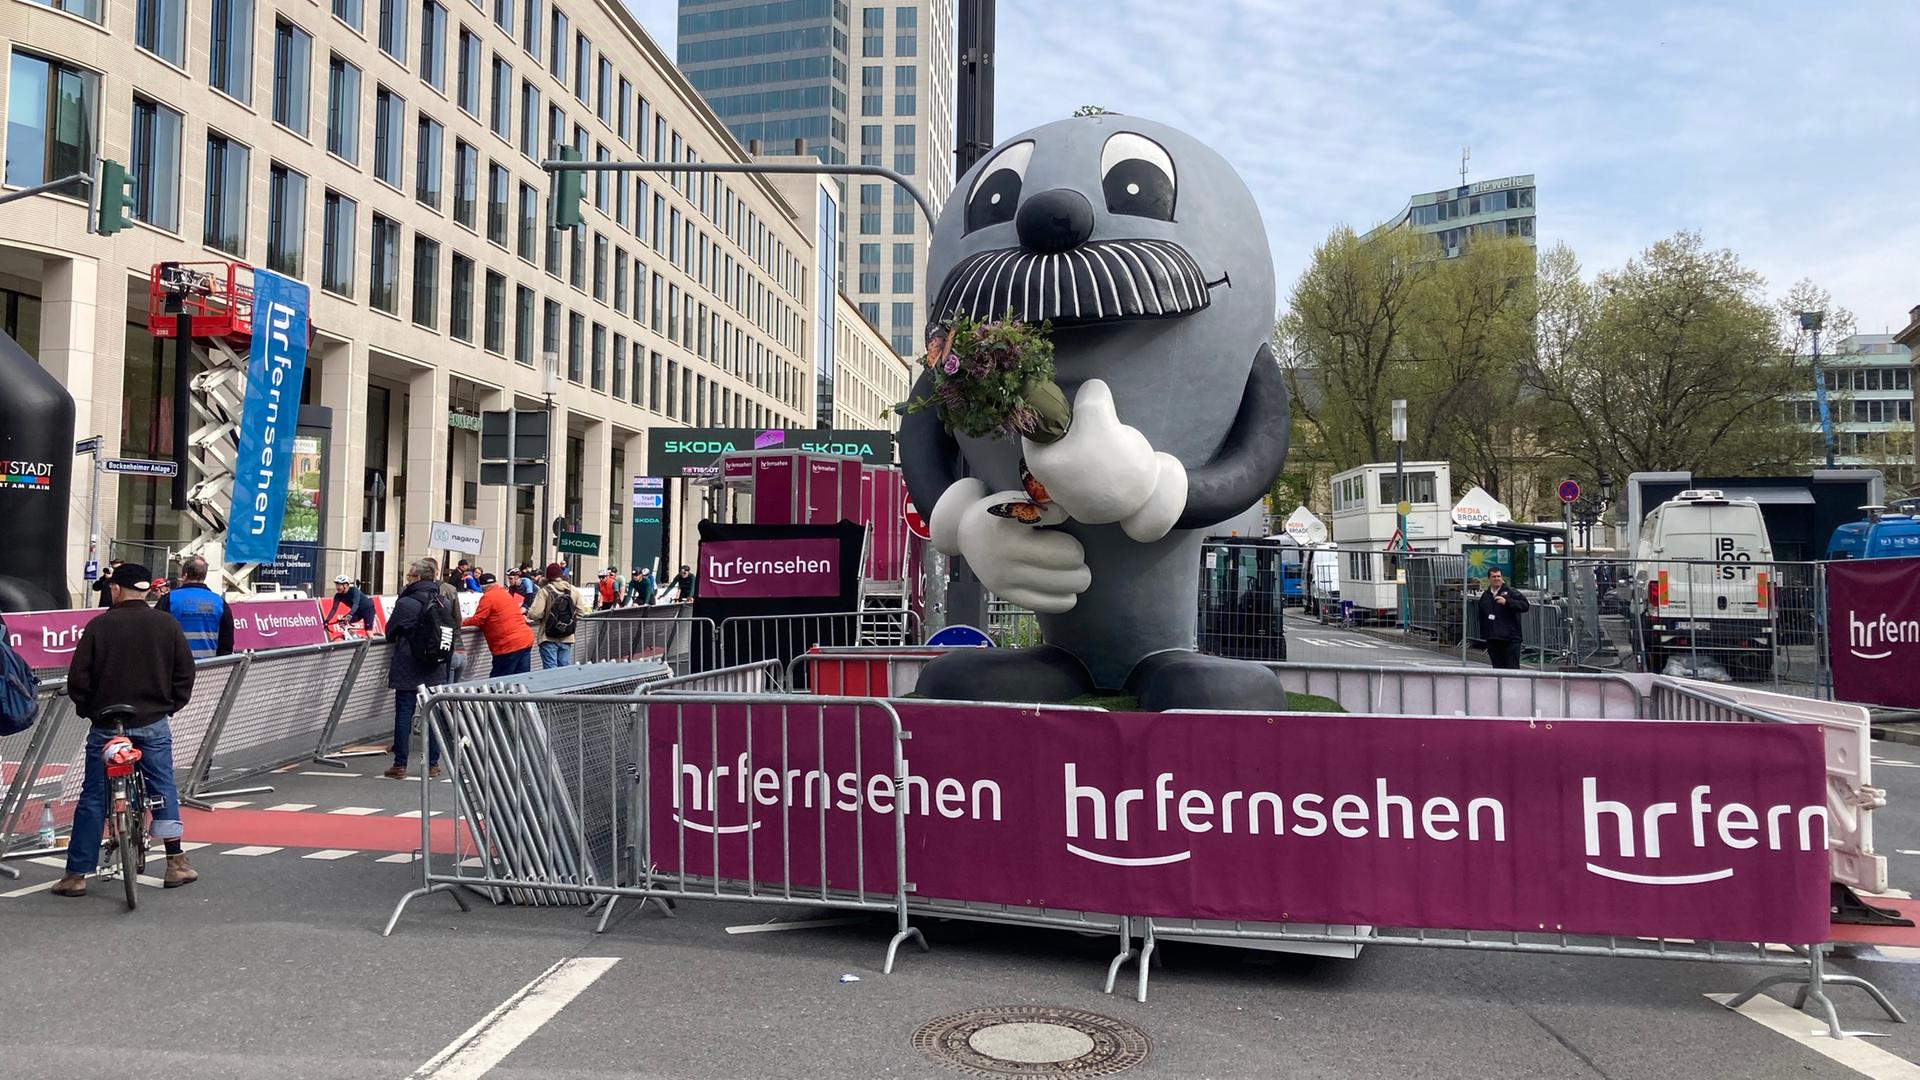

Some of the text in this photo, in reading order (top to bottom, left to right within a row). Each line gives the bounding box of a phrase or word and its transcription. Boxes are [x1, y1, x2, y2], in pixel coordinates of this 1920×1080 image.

[1491, 176, 1523, 190] welle
[252, 303, 296, 535] hr fernsehen
[108, 461, 171, 473] Bockenheimer Anlage
[452, 534, 480, 544] nagarro
[710, 556, 830, 578] hr fernsehen
[254, 613, 269, 631] hr
[269, 613, 318, 628] fernsehen
[1850, 610, 1919, 647] hr fern
[42, 626, 69, 647] hr
[440, 626, 453, 652] NIKE
[672, 744, 1001, 821] hr fernsehen
[1065, 763, 1505, 842] hr fernsehen
[1582, 777, 1828, 858] hr fern
